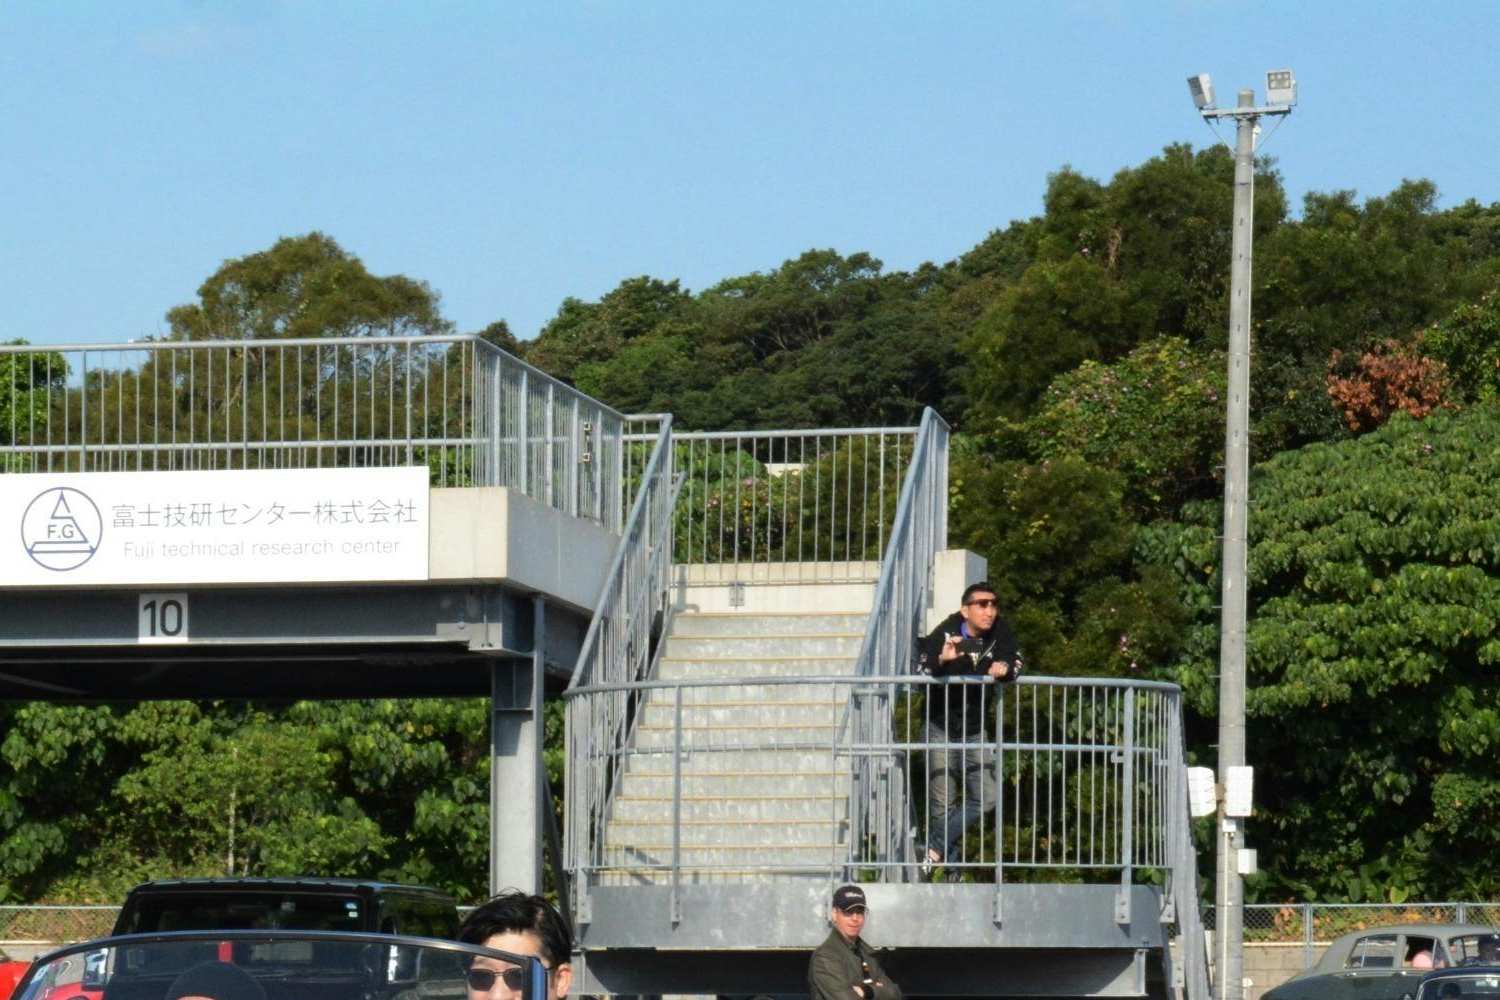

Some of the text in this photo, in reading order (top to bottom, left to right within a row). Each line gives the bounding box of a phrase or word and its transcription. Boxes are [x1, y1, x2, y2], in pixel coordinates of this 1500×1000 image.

[112, 498, 419, 528] 富士技研センター株式会社
[123, 537, 401, 559] Fuji technical research center
[142, 600, 183, 637] 10
